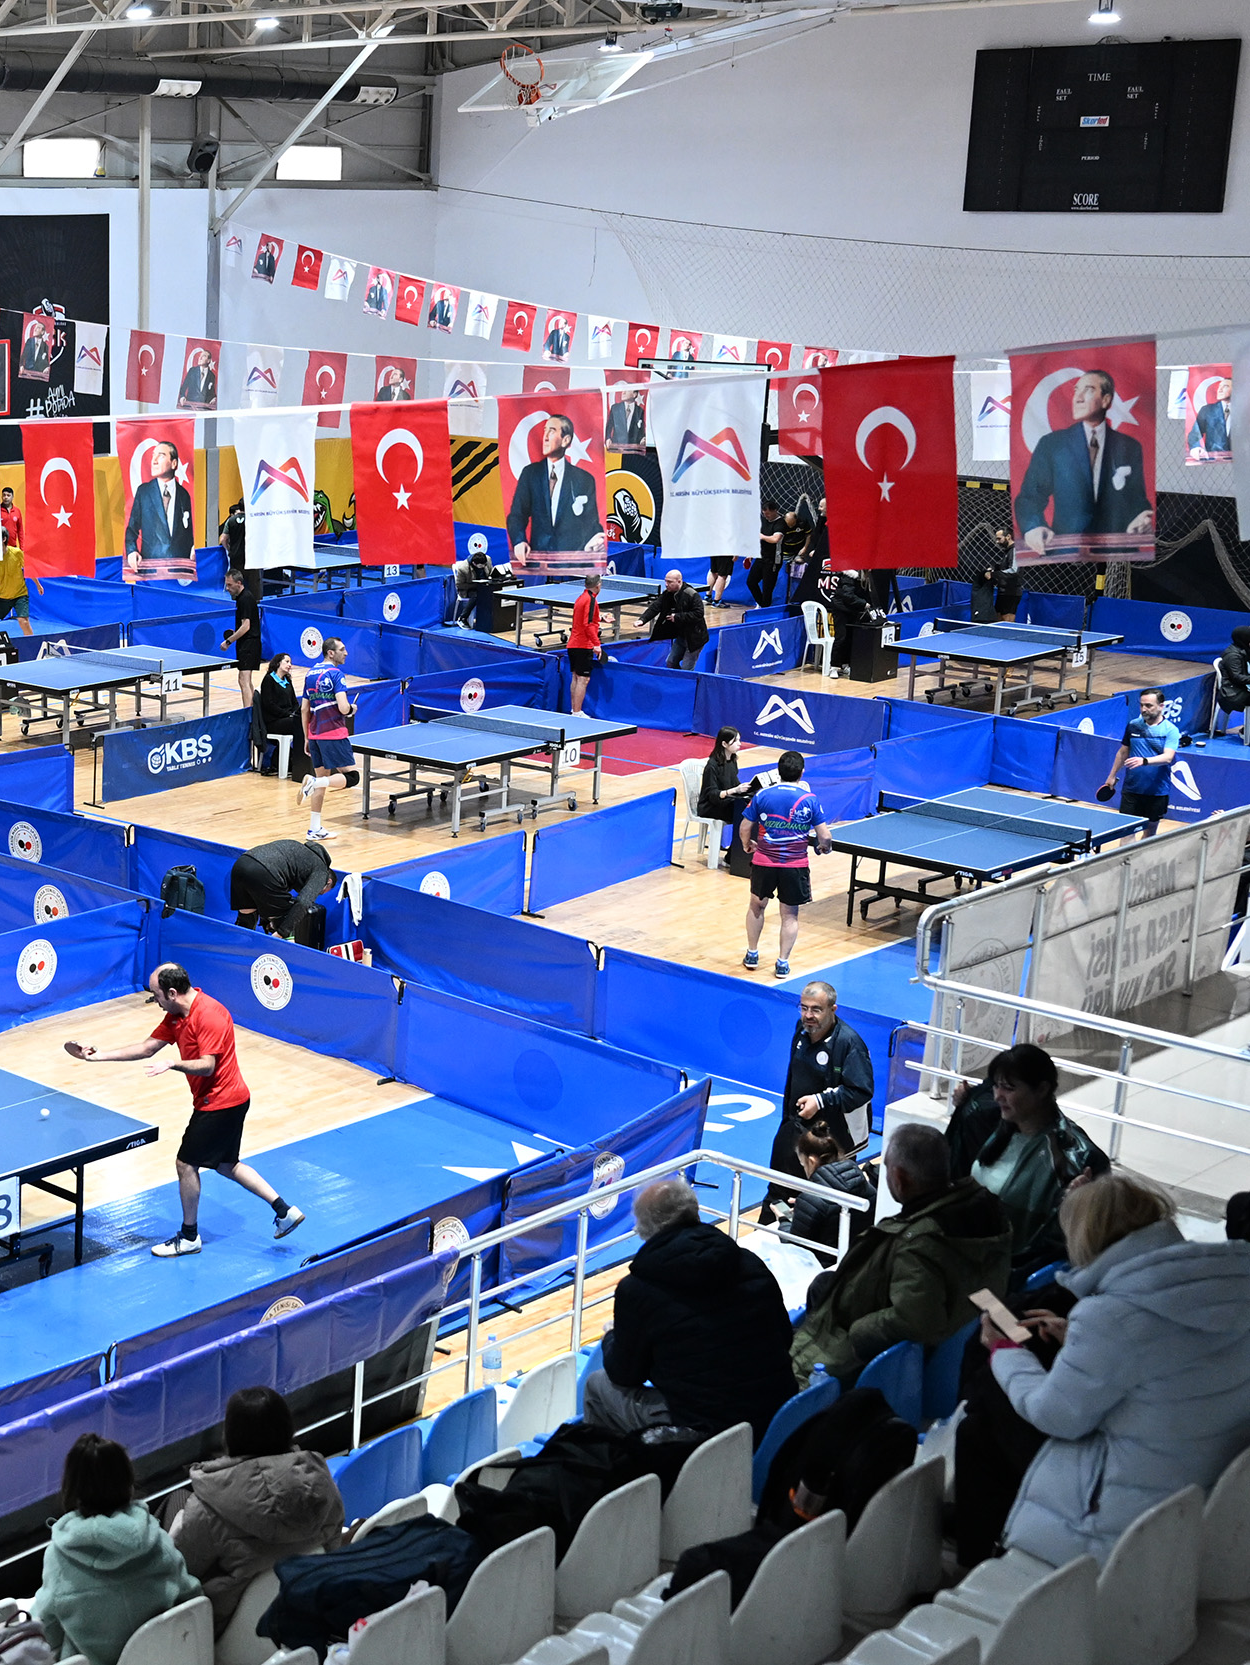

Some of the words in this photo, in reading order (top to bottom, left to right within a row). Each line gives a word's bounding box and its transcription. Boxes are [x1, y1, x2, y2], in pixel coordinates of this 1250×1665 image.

[1088, 73, 1111, 81] TIME
[1073, 193, 1100, 206] SCORE
[386, 565, 398, 576] 13
[883, 633, 893, 644] 15
[1075, 652, 1085, 664] 15
[164, 678, 180, 692] 11
[165, 734, 213, 765] KBS
[564, 747, 577, 763] 10
[126, 1138, 146, 1150] STIGA
